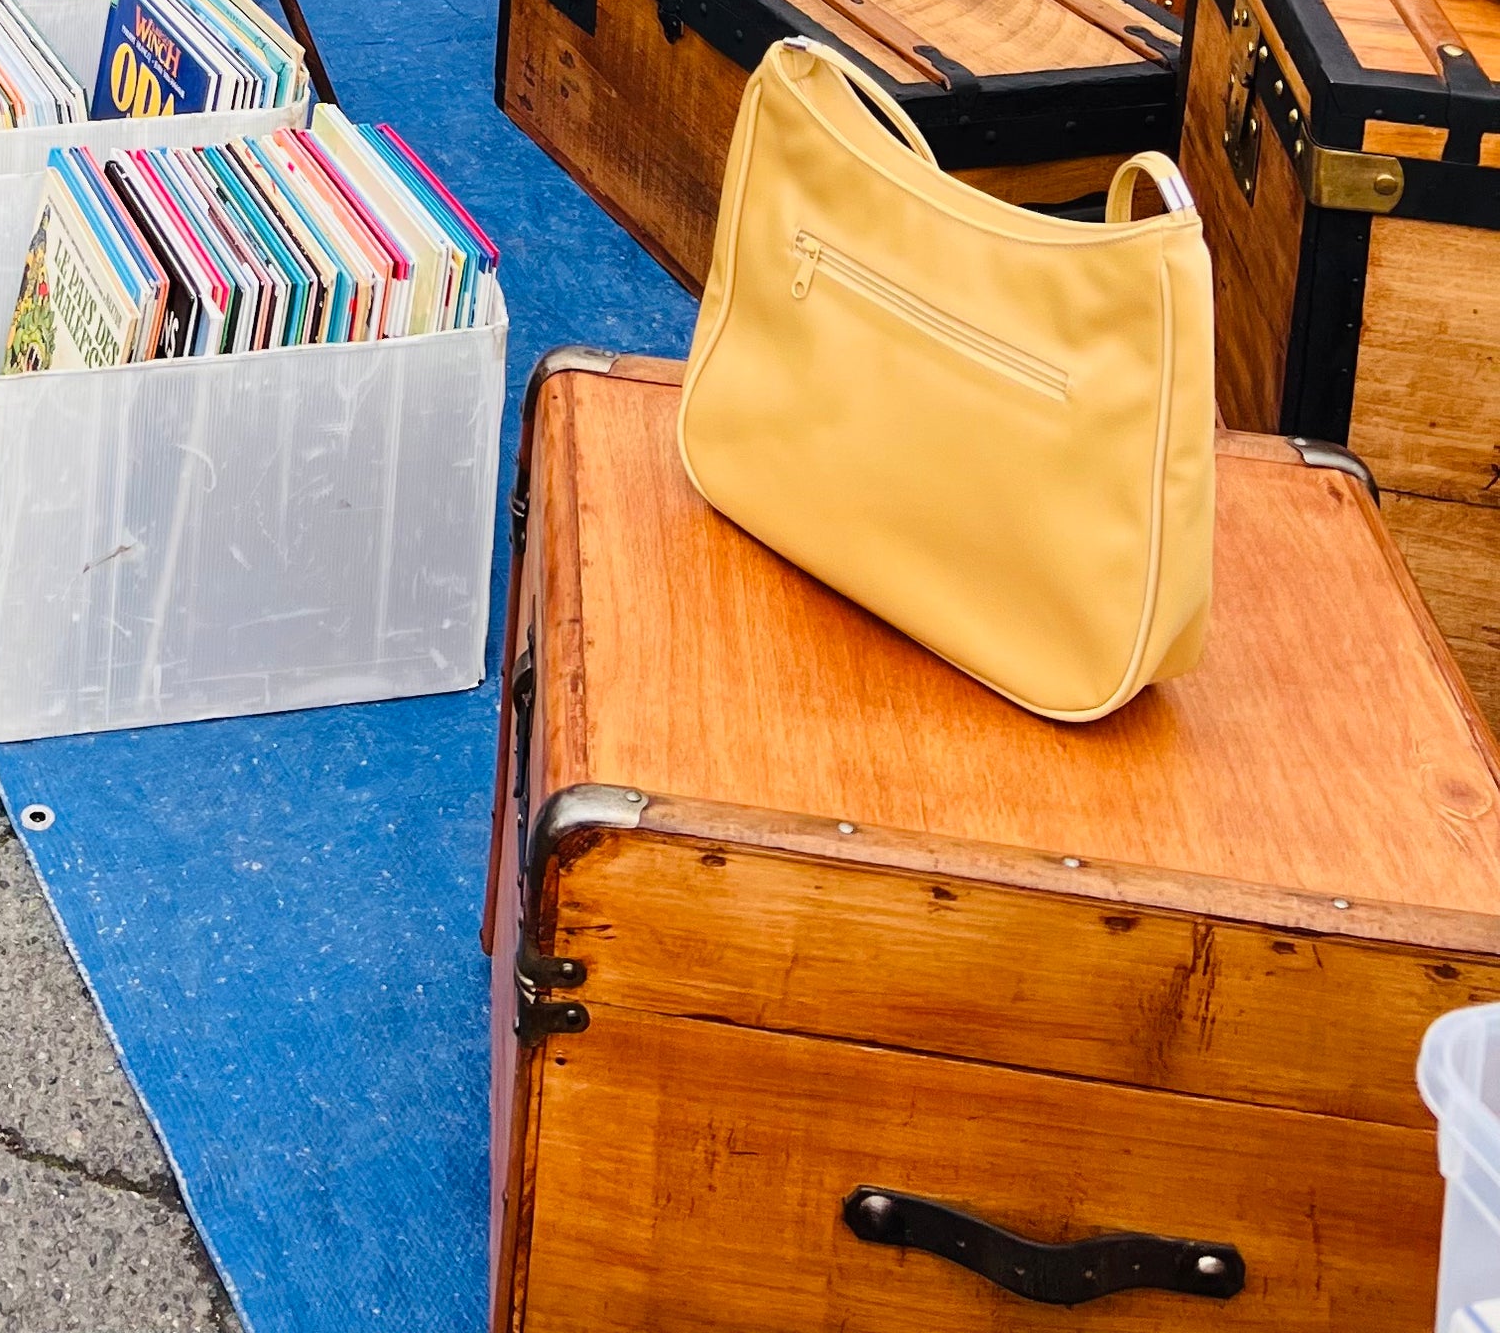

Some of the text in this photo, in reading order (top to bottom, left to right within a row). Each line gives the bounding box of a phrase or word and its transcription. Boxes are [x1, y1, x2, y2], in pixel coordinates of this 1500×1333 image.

[54, 237, 71, 279] LE
[69, 262, 97, 326] PAYS
[95, 312, 120, 366] DES
